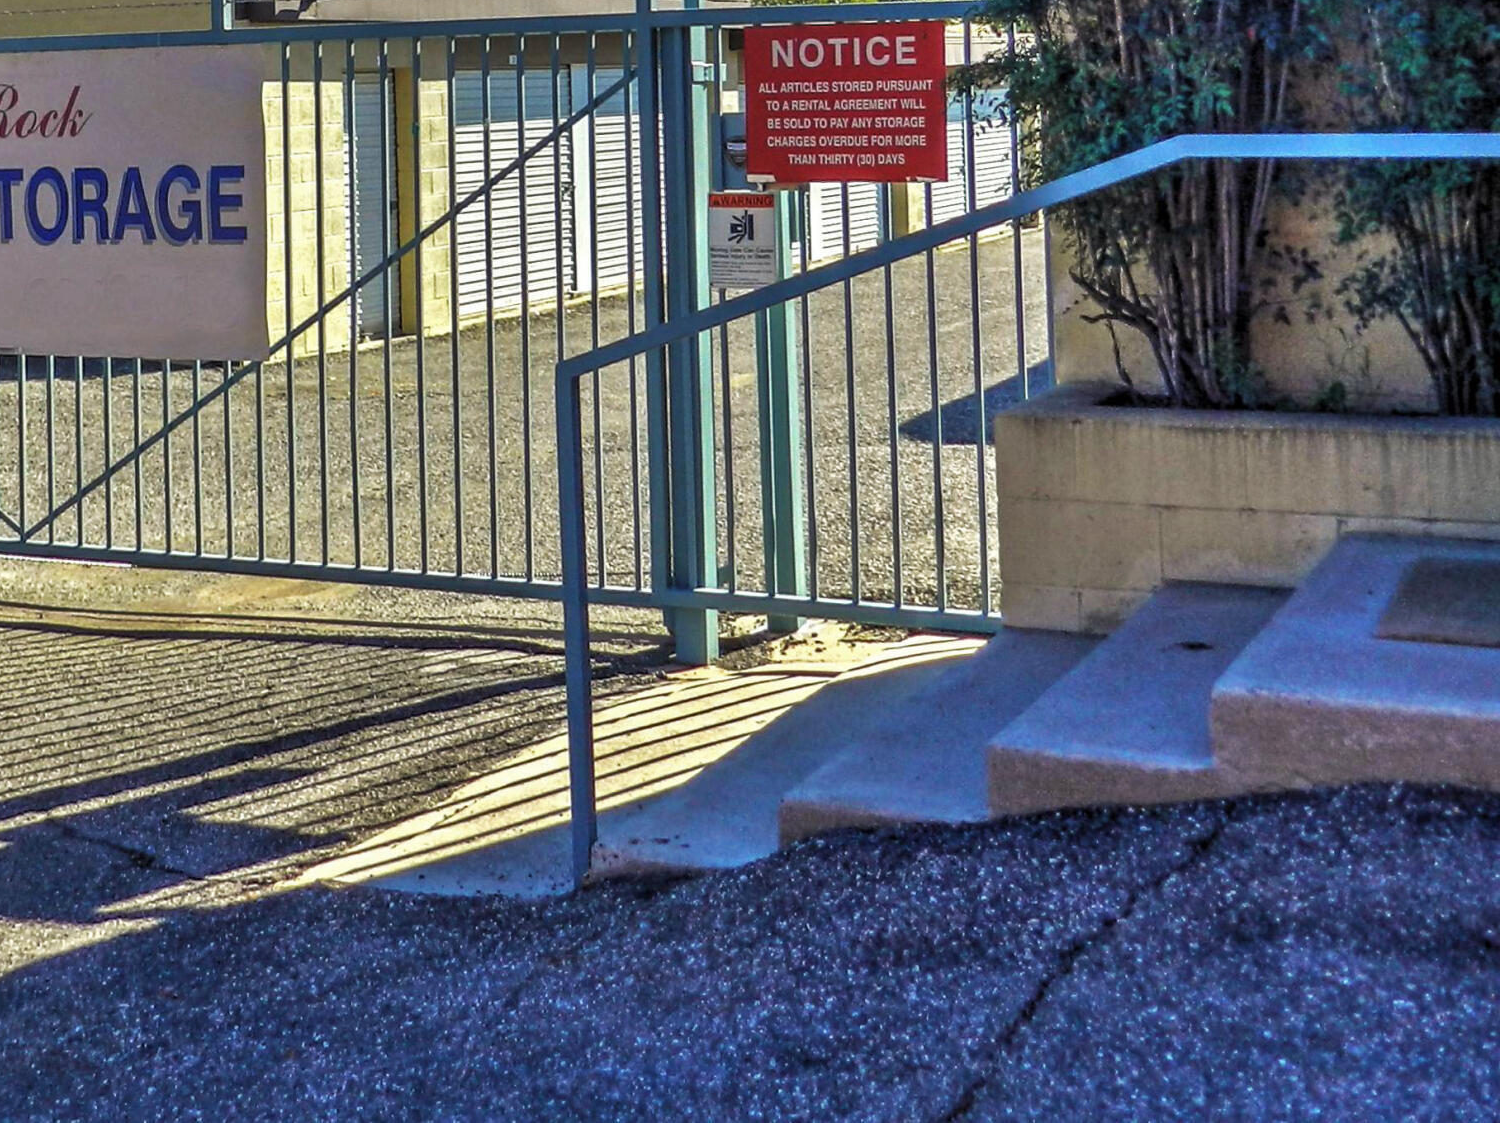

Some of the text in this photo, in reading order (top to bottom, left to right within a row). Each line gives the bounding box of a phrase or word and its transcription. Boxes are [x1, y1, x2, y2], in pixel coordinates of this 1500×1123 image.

[771, 35, 917, 68] NOTICE
[759, 80, 933, 94] ALL ARTICLES STORED PURSUANT
[766, 99, 926, 111] TO A RENTAL AGREEMENT WILL
[767, 116, 925, 129] BE SOLD TO PAY ANY STORAGE
[767, 135, 927, 147] CHARGES OVERDUE FOR MORE
[788, 153, 905, 167] THAN THIRTY (30) DAYS
[720, 196, 773, 206] WARNING
